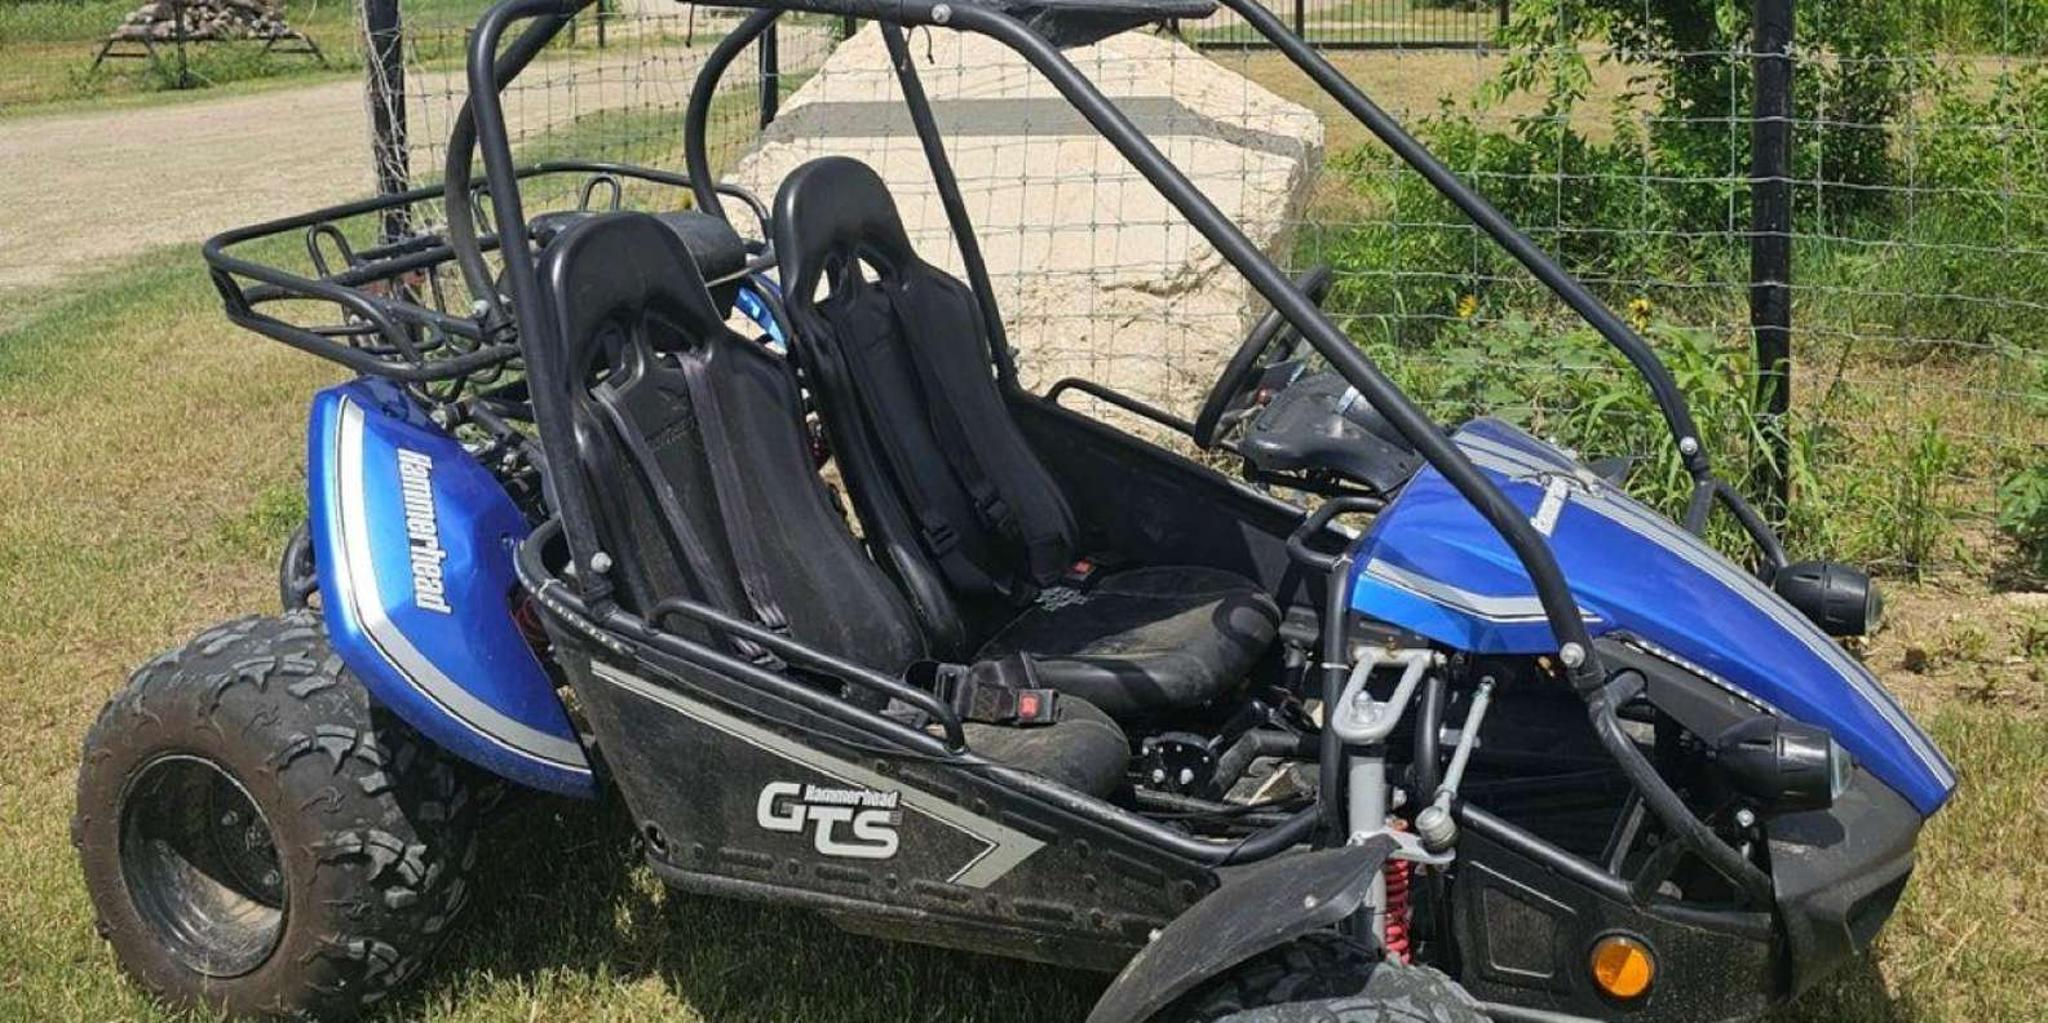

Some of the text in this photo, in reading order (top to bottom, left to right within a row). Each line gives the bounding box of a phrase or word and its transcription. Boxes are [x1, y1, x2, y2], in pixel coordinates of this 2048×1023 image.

[398, 448, 452, 614] Hammerhead
[757, 781, 900, 859] GTS
[804, 784, 898, 808] Hammerhead
